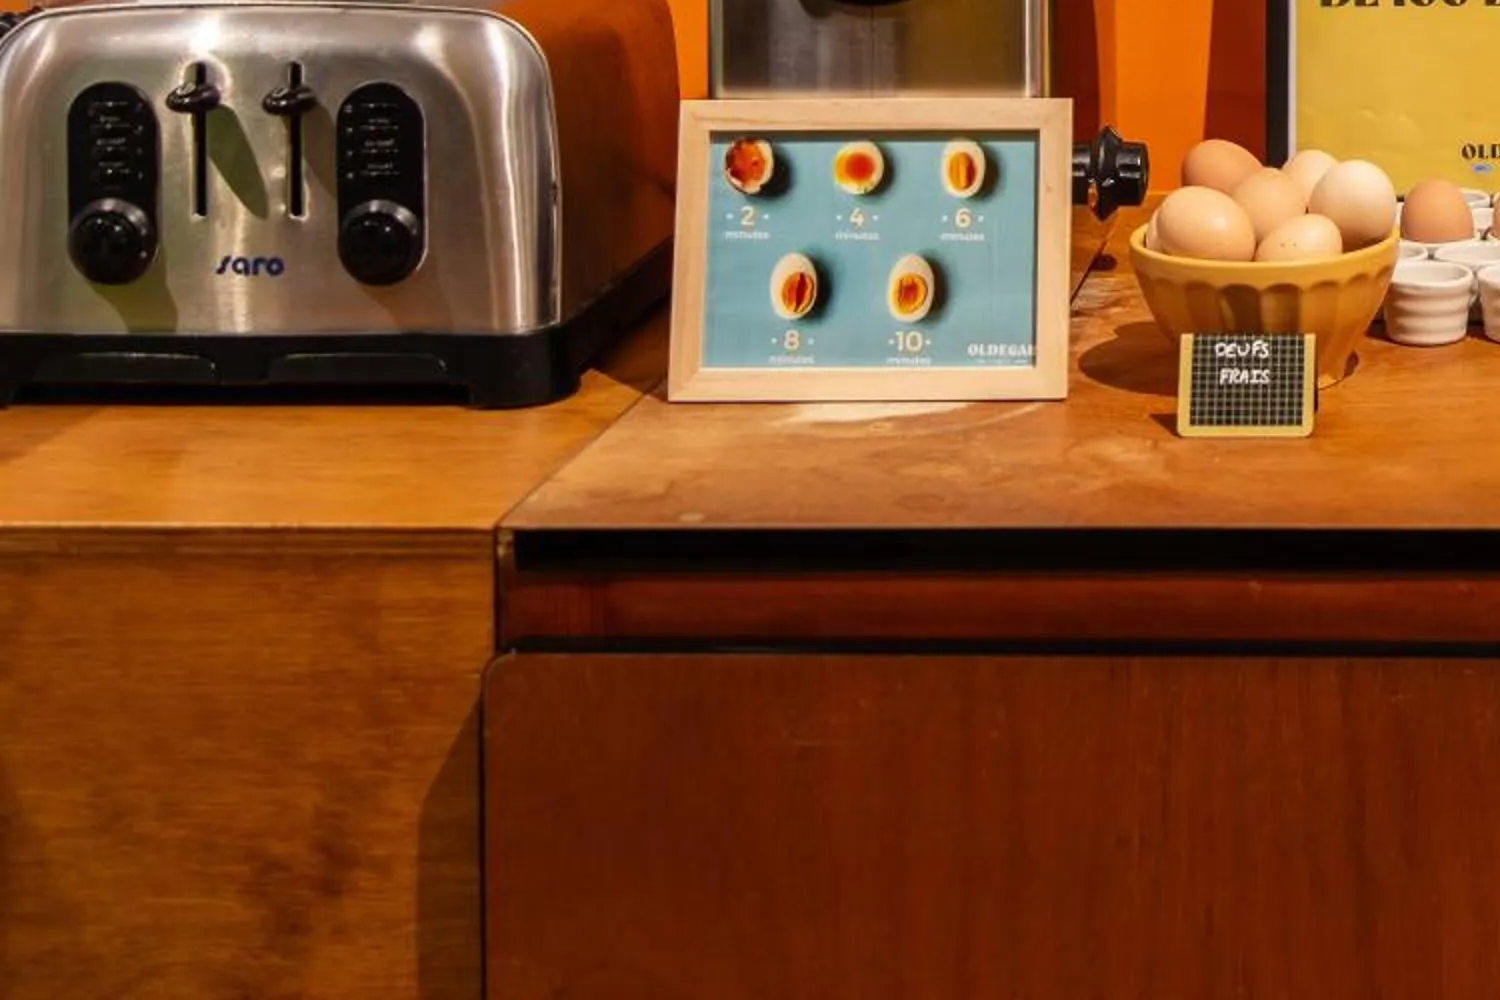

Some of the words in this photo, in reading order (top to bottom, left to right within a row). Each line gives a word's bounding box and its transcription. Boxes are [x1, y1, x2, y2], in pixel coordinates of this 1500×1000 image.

[740, 206, 755, 226] 2
[849, 208, 865, 227] 4
[954, 208, 972, 228] 6
[216, 255, 285, 276] saro
[783, 330, 800, 350] 8
[896, 331, 923, 352] 10
[1219, 368, 1270, 385] FRAIS
